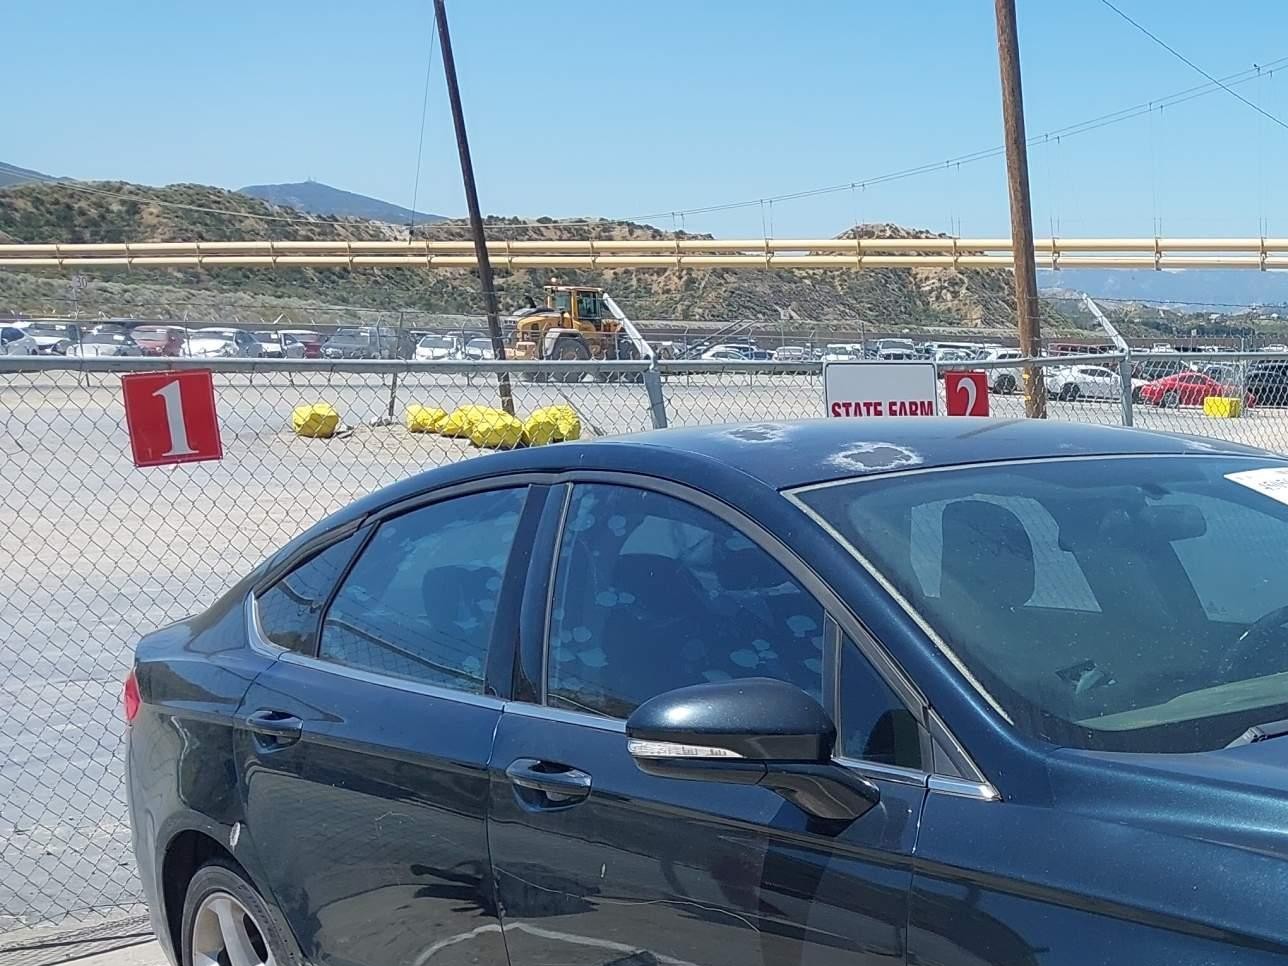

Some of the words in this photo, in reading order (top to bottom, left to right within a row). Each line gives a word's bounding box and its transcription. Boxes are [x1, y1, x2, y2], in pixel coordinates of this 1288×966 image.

[151, 379, 200, 457] 1
[831, 401, 883, 418] STATE
[888, 400, 934, 418] FARM
